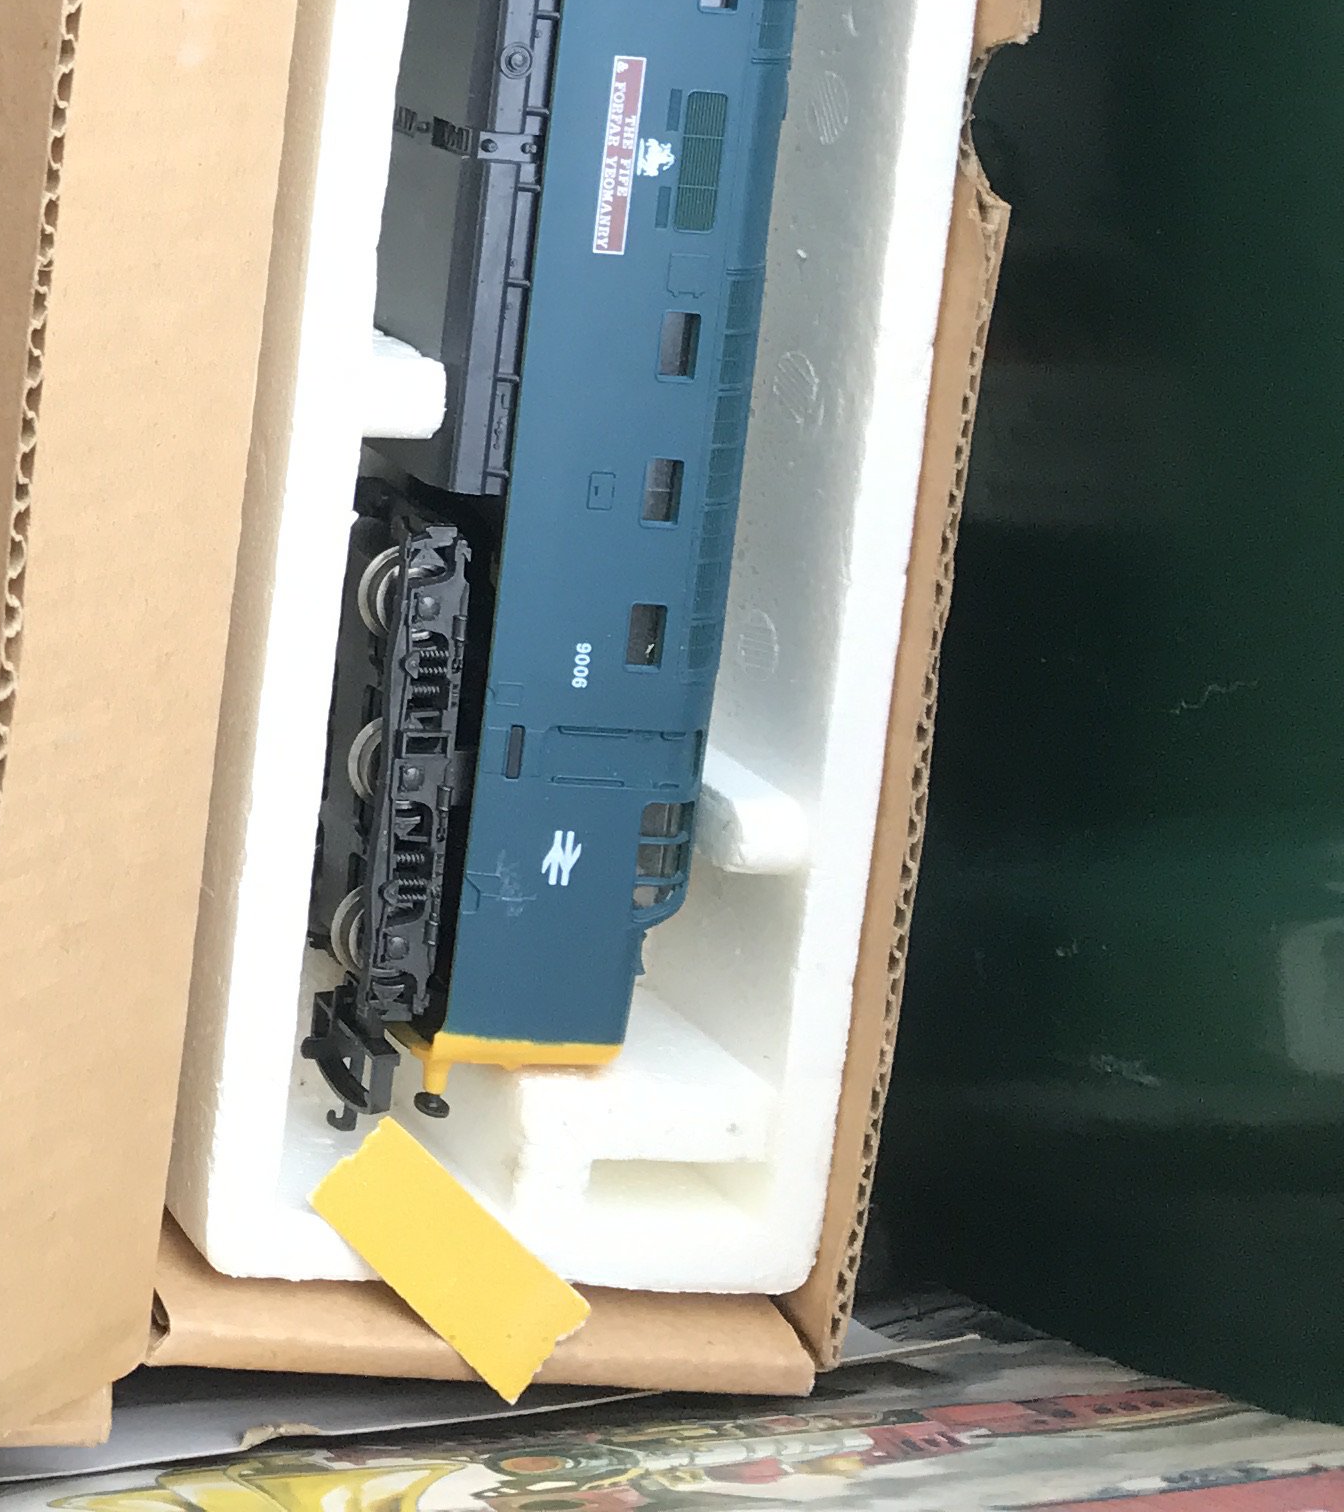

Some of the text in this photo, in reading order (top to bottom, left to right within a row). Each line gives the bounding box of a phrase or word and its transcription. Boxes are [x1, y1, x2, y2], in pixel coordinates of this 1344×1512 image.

[607, 82, 626, 146] FORFAR
[617, 116, 636, 196] THE FIFE
[597, 156, 617, 248] YEOMANRY
